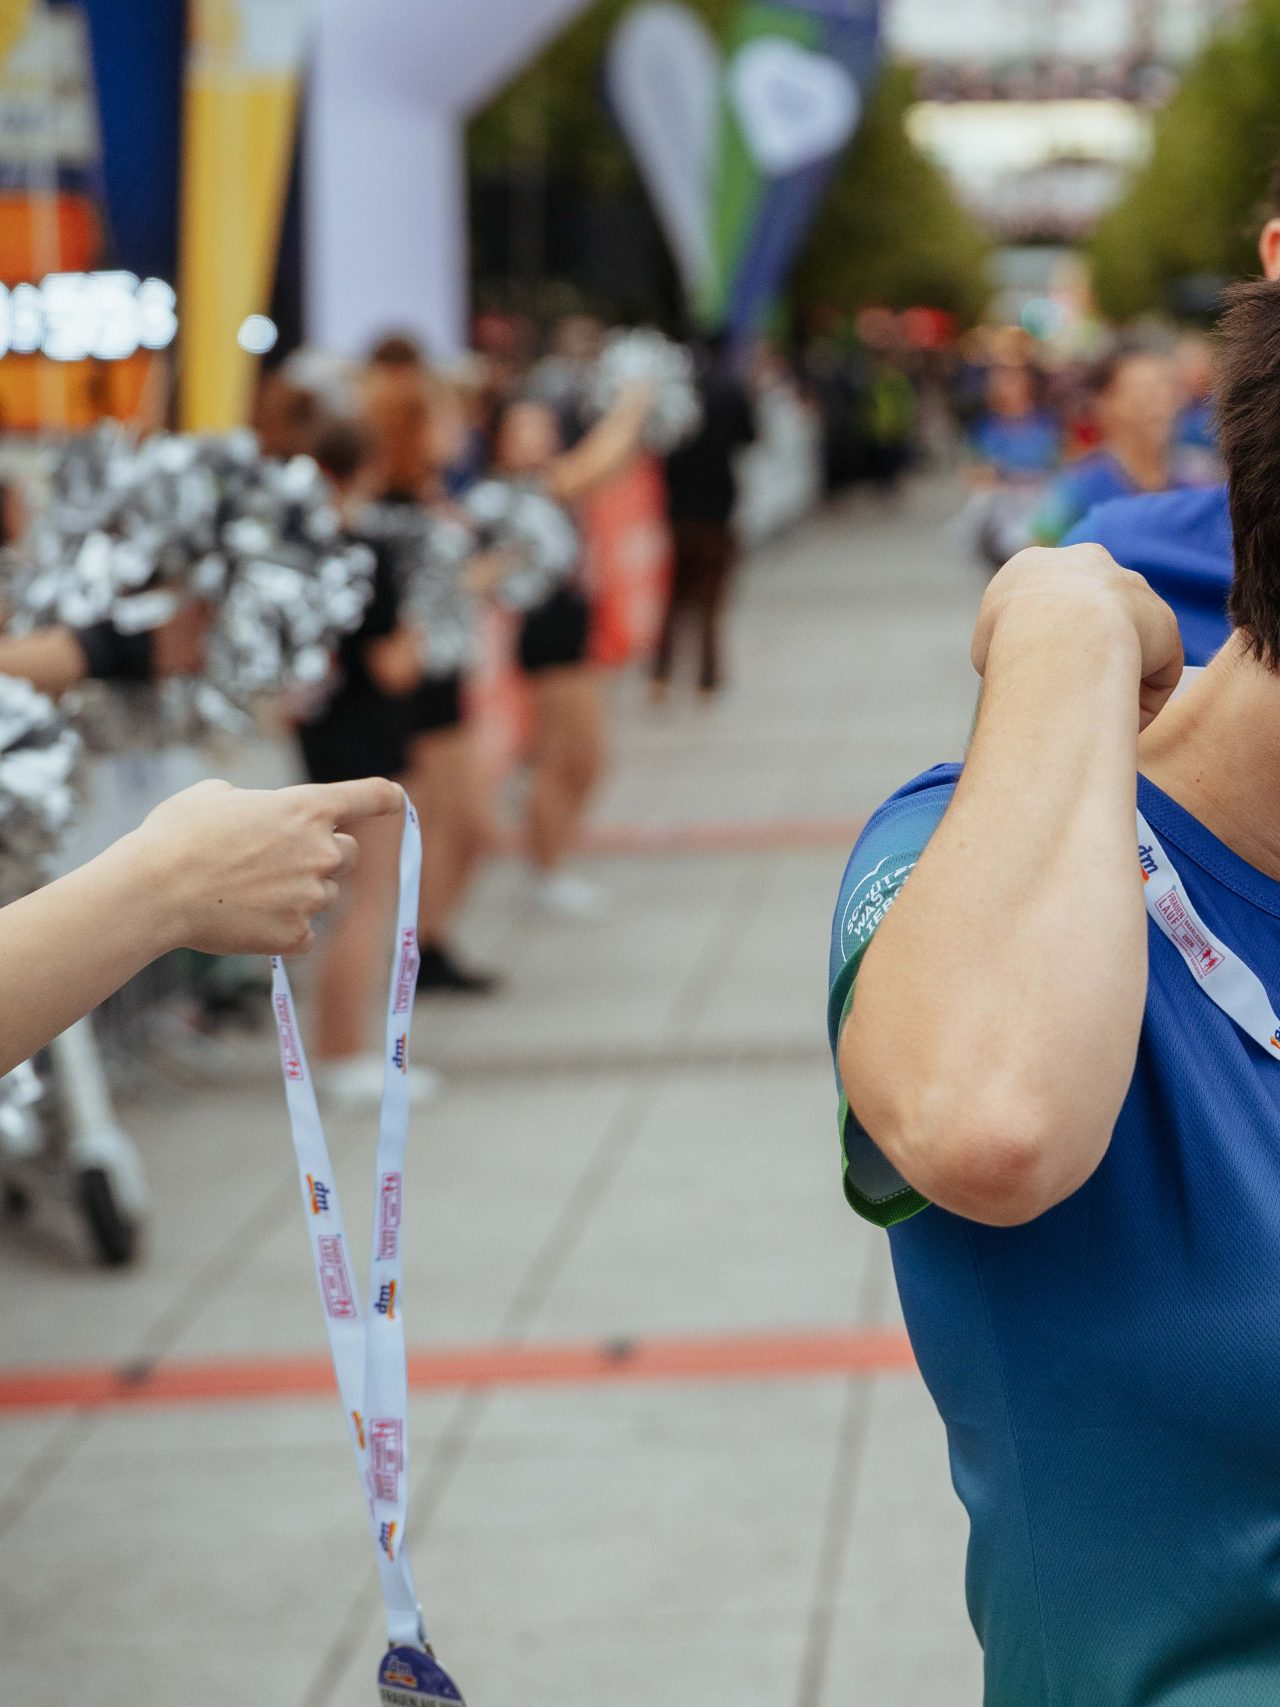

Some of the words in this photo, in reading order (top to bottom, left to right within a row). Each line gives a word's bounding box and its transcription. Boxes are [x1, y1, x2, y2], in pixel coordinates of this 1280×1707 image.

[1138, 845, 1159, 875] dm
[1158, 898, 1180, 925] LAUF
[392, 1038, 403, 1069] dm
[314, 1180, 330, 1211] dm
[374, 1285, 391, 1315] dm
[379, 1521, 391, 1552] dm
